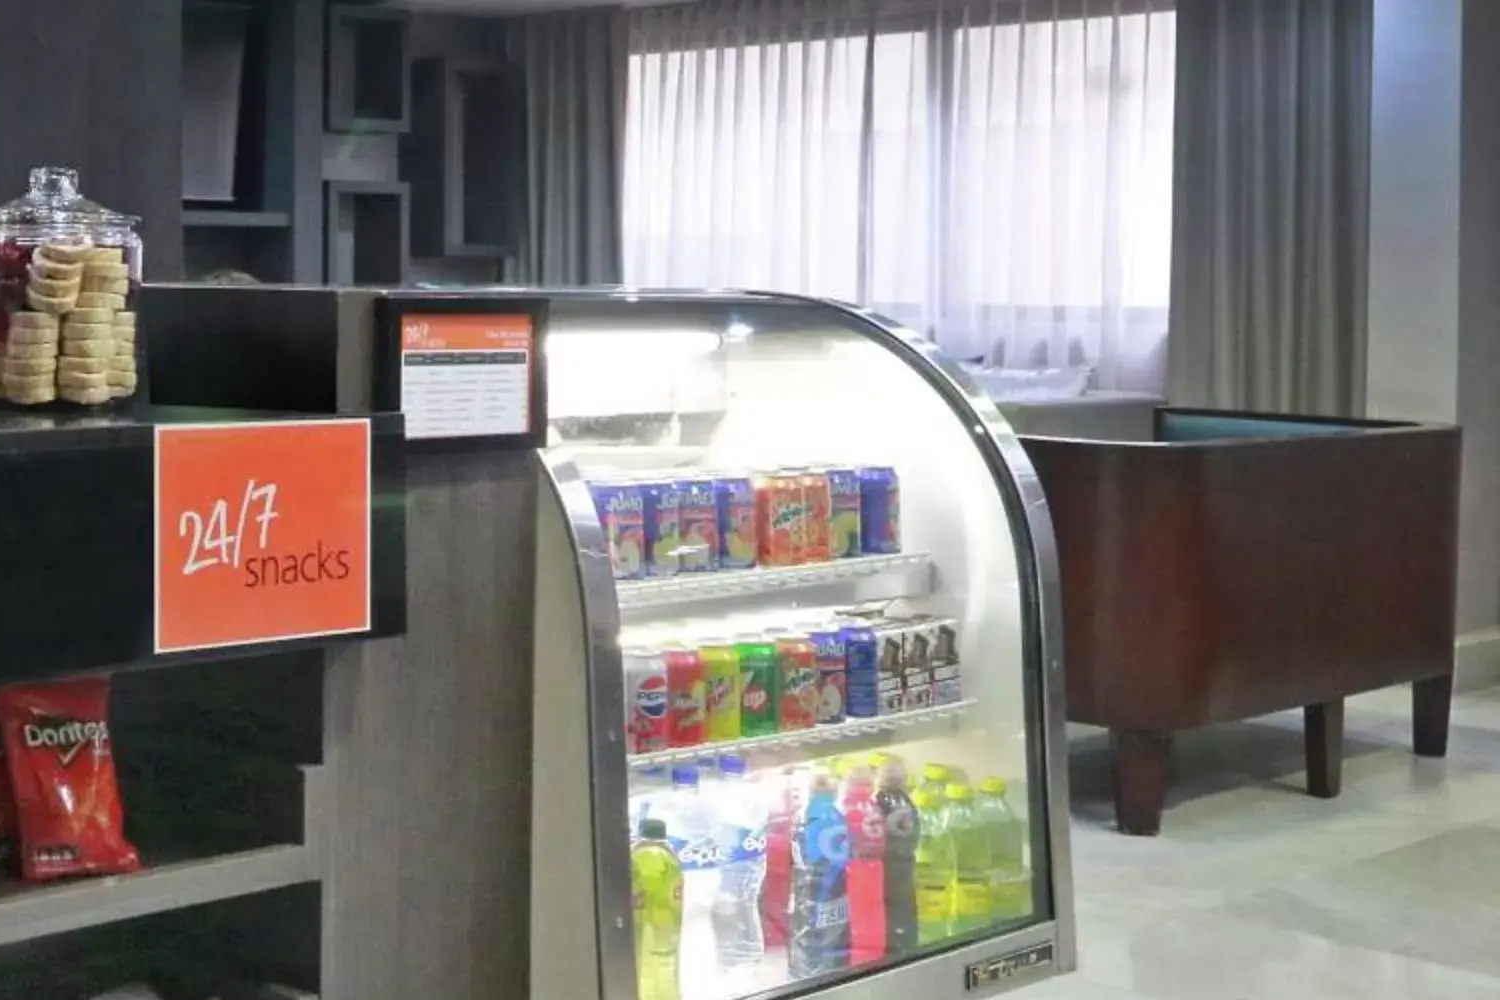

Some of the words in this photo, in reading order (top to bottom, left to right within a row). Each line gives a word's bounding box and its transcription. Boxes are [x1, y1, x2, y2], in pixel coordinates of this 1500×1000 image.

[179, 479, 280, 575] 24/7
[243, 539, 351, 588] snacks
[23, 720, 109, 748] Doritos
